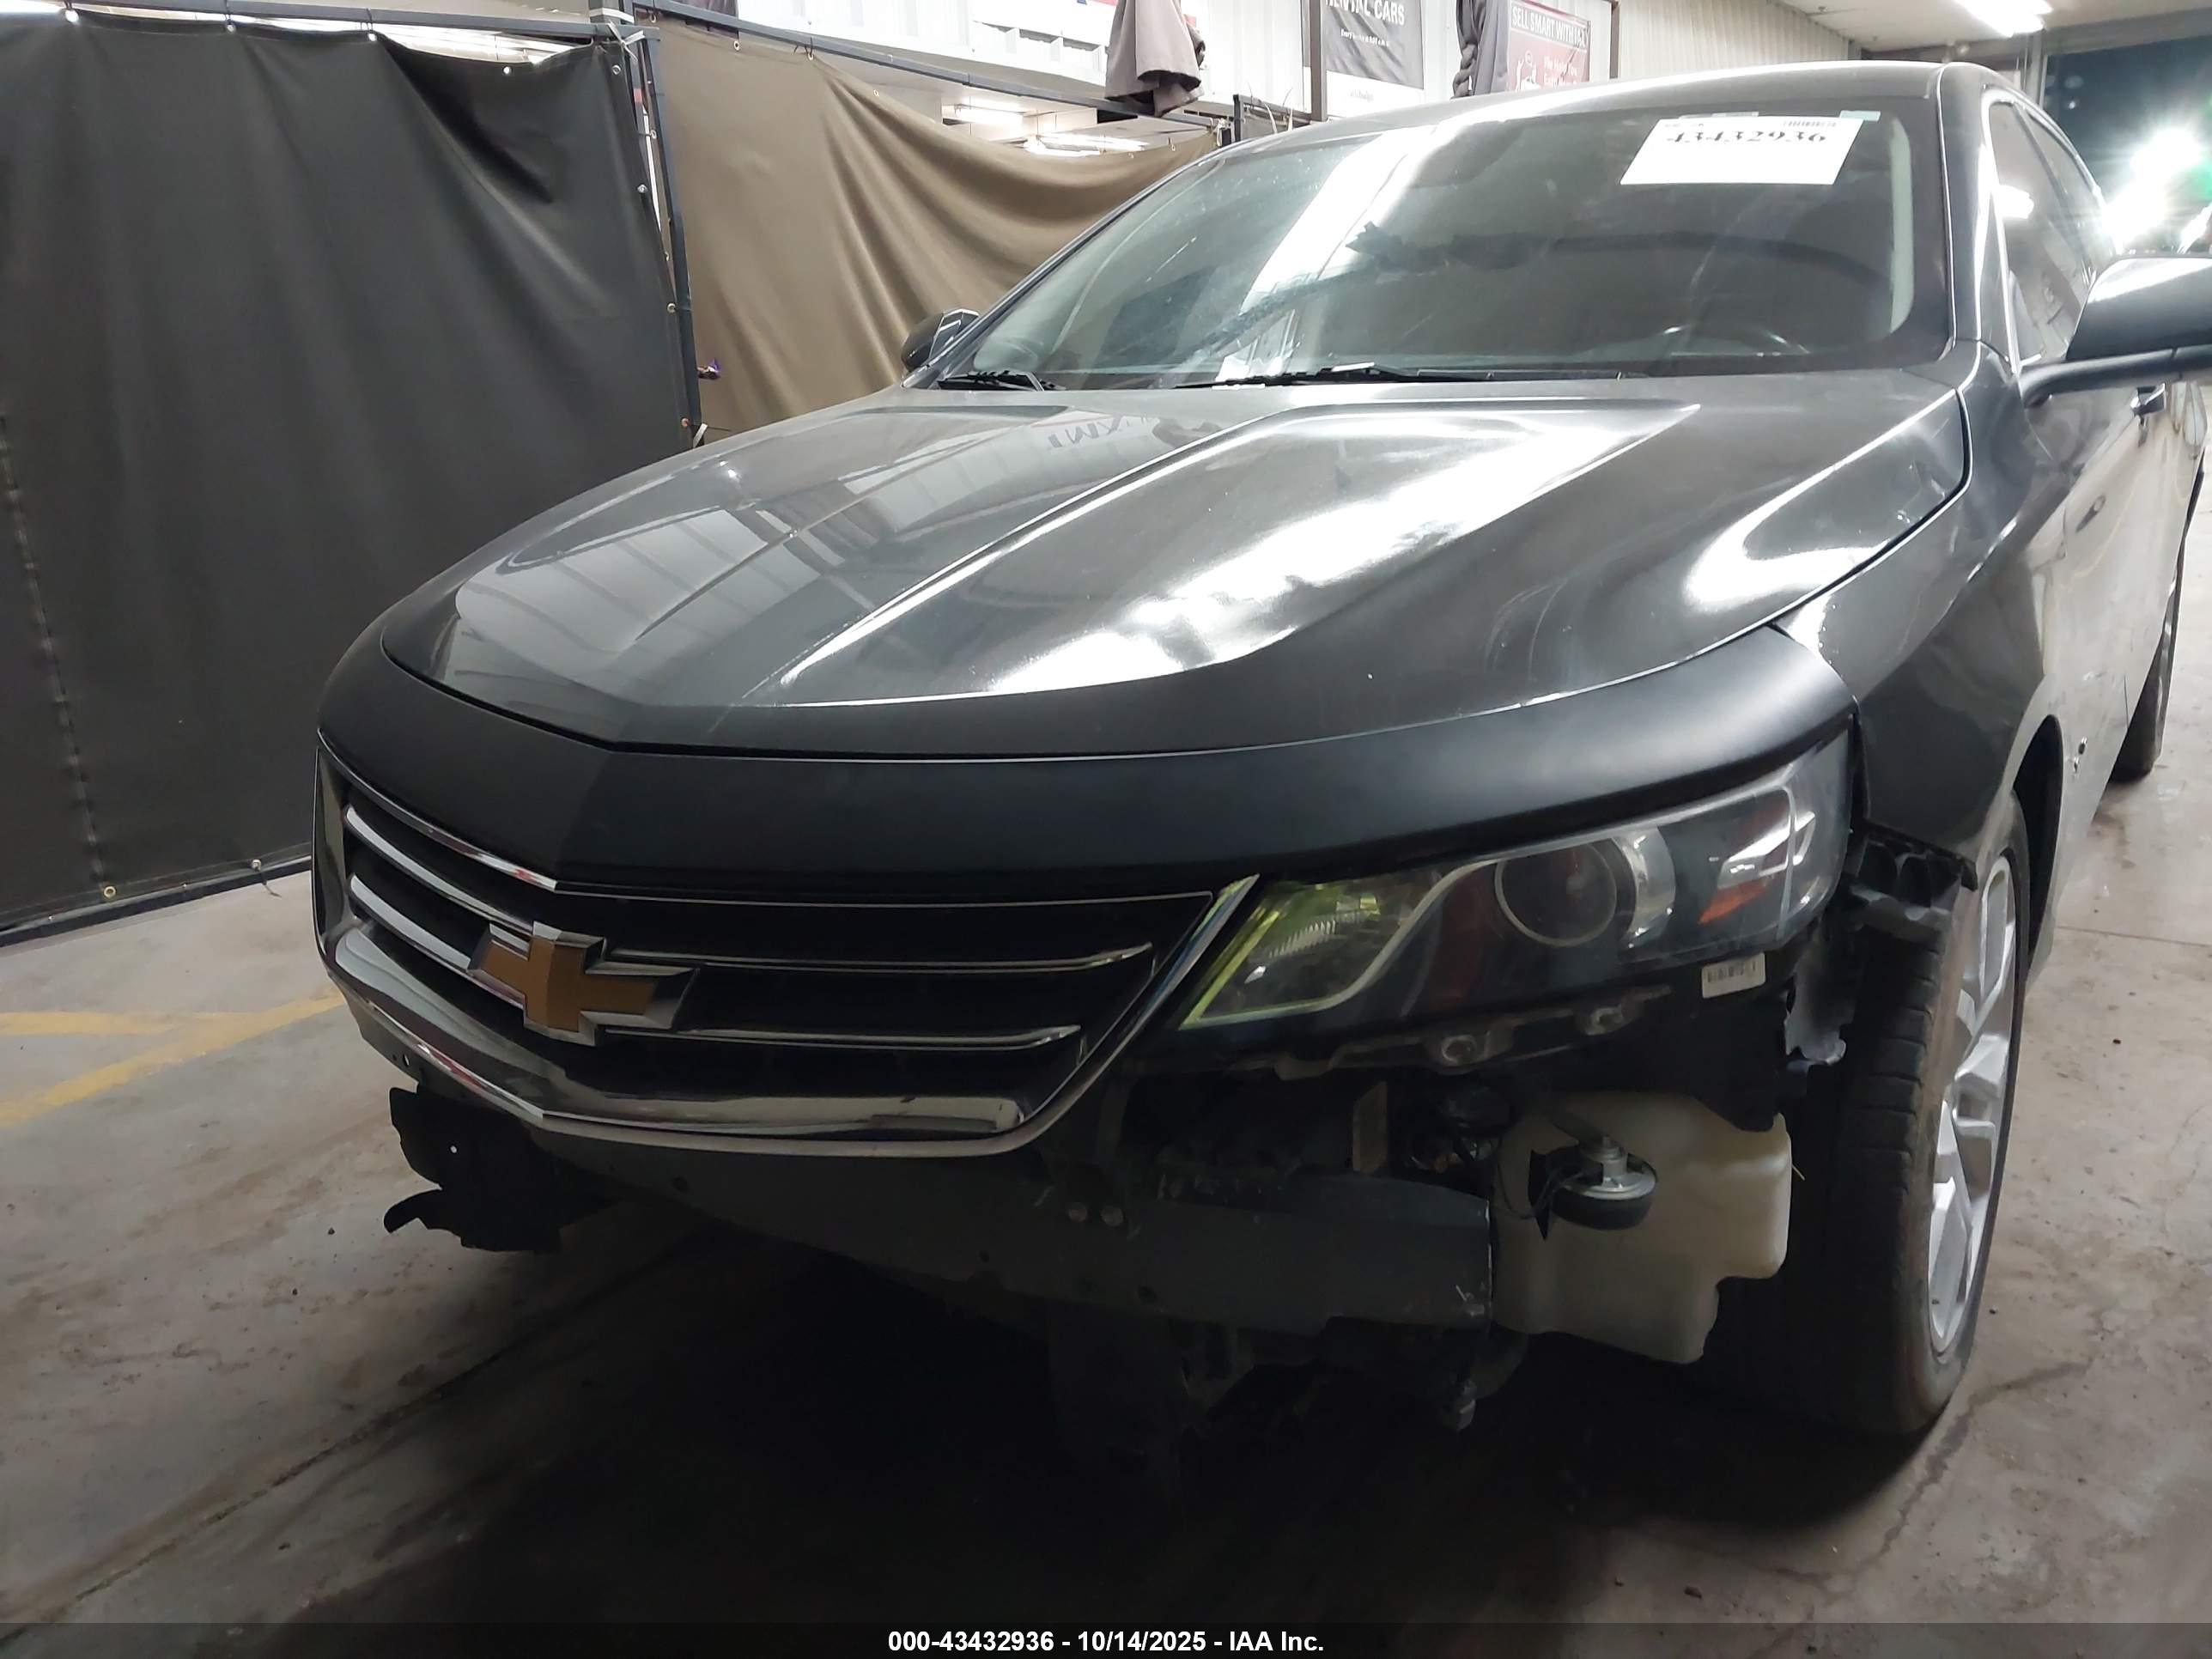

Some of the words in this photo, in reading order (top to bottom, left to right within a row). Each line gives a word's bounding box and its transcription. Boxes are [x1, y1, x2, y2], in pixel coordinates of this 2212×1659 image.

[1374, 0, 1404, 26] CARS
[1512, 6, 1528, 29] SELL
[1530, 12, 1555, 38] SMART
[1555, 21, 1574, 43] WITH
[1667, 131, 1826, 143] 43432936
